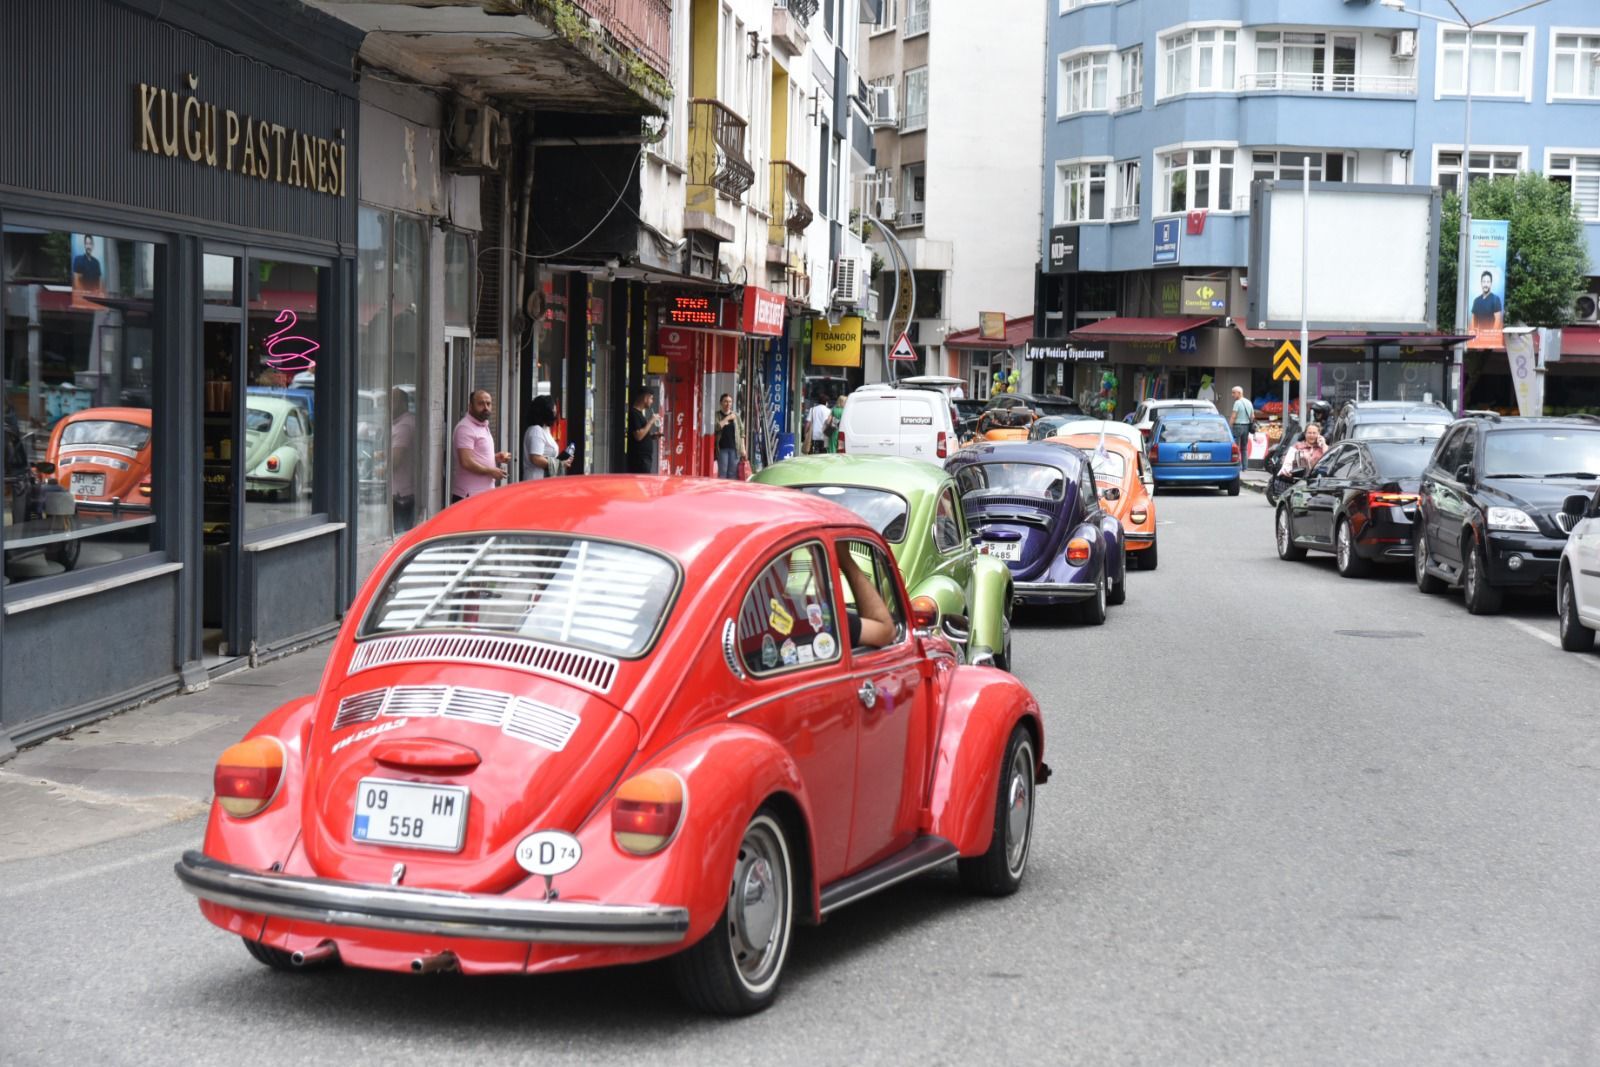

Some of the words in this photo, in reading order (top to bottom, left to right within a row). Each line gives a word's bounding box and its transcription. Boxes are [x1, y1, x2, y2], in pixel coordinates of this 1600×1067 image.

[139, 72, 217, 167] KUĞU
[226, 109, 345, 197] PASTANESİ
[824, 343, 847, 352] SHOP
[1180, 336, 1197, 350] SA
[1006, 543, 1017, 551] AP
[366, 788, 389, 810] 09
[431, 794, 455, 817] HM
[389, 815, 424, 838] 558
[520, 846, 533, 860] 19
[539, 841, 555, 865] D
[560, 846, 576, 860] 74
